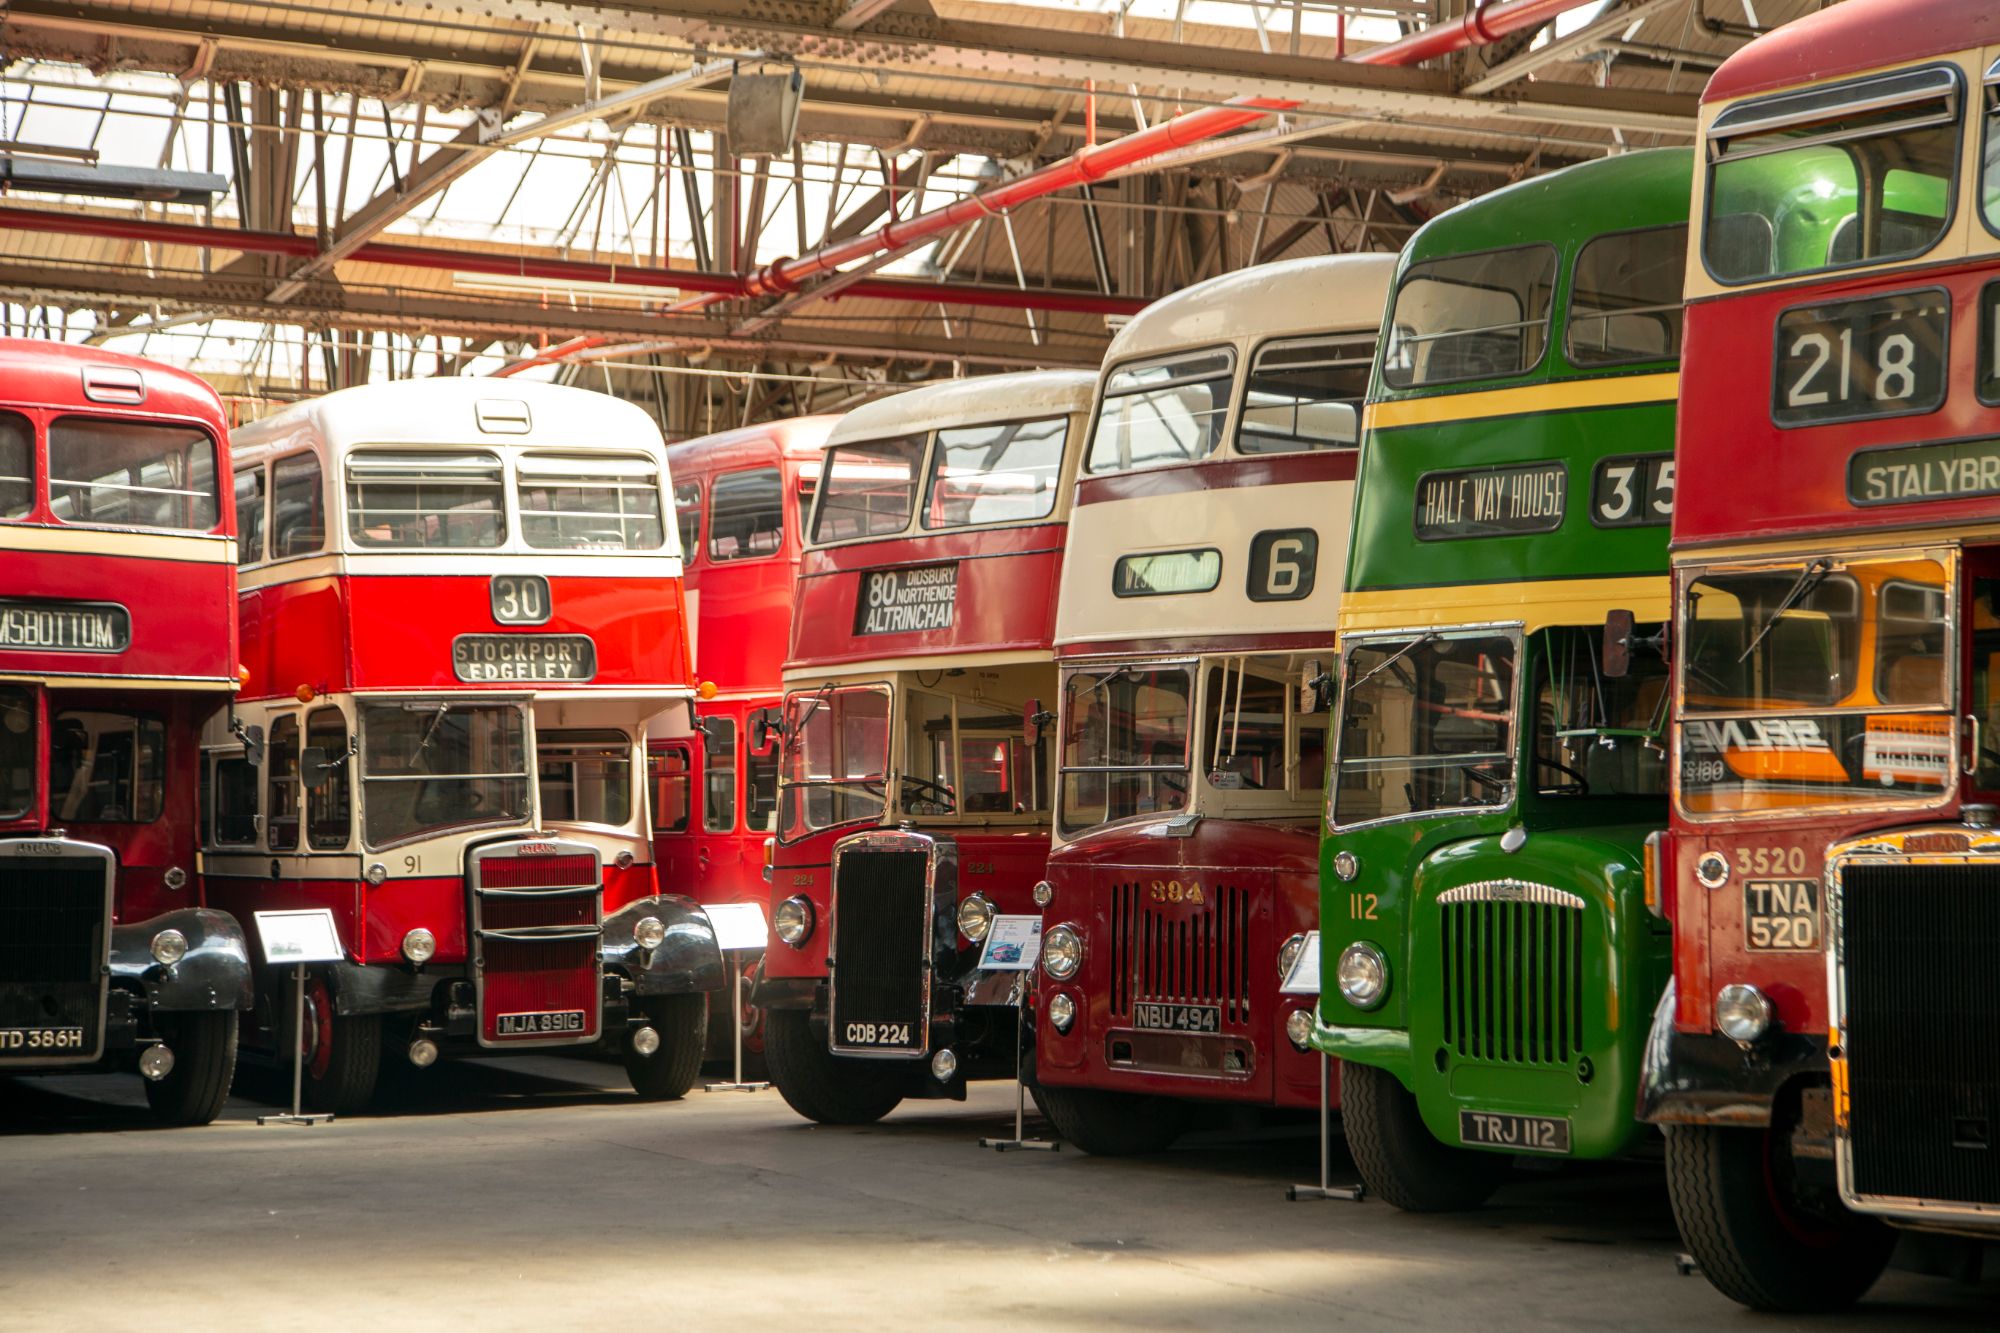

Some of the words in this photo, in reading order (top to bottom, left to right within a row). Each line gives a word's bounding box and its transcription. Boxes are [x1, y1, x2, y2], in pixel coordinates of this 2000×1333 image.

[1788, 328, 1915, 407] 218
[1866, 456, 2000, 500] STALYBR
[1425, 479, 1468, 525] HALF
[1474, 475, 1504, 521] WAY
[1510, 471, 1564, 518] HOUSE
[906, 567, 956, 586] DIDSBURY
[1266, 539, 1304, 594] 6
[498, 578, 541, 618] 30
[868, 572, 898, 607] 80
[456, 642, 584, 662] STOCKPORT
[404, 855, 422, 873] 91
[967, 862, 995, 874] 224
[1735, 847, 1806, 875] 3520
[793, 874, 814, 886] 224
[1151, 880, 1205, 905] 394
[1350, 893, 1379, 920] 112
[1750, 883, 1813, 915] TNA
[1751, 917, 1813, 947] 520
[503, 1016, 538, 1033] MJA
[540, 1013, 580, 1031] 891G
[1137, 1005, 1173, 1029] NBU
[1176, 1007, 1216, 1032] 494
[27, 1030, 82, 1048] 386H
[846, 1023, 876, 1043] CDB
[878, 1024, 910, 1045] 224
[1472, 1114, 1518, 1144] TRJ
[1523, 1119, 1556, 1147] 112
